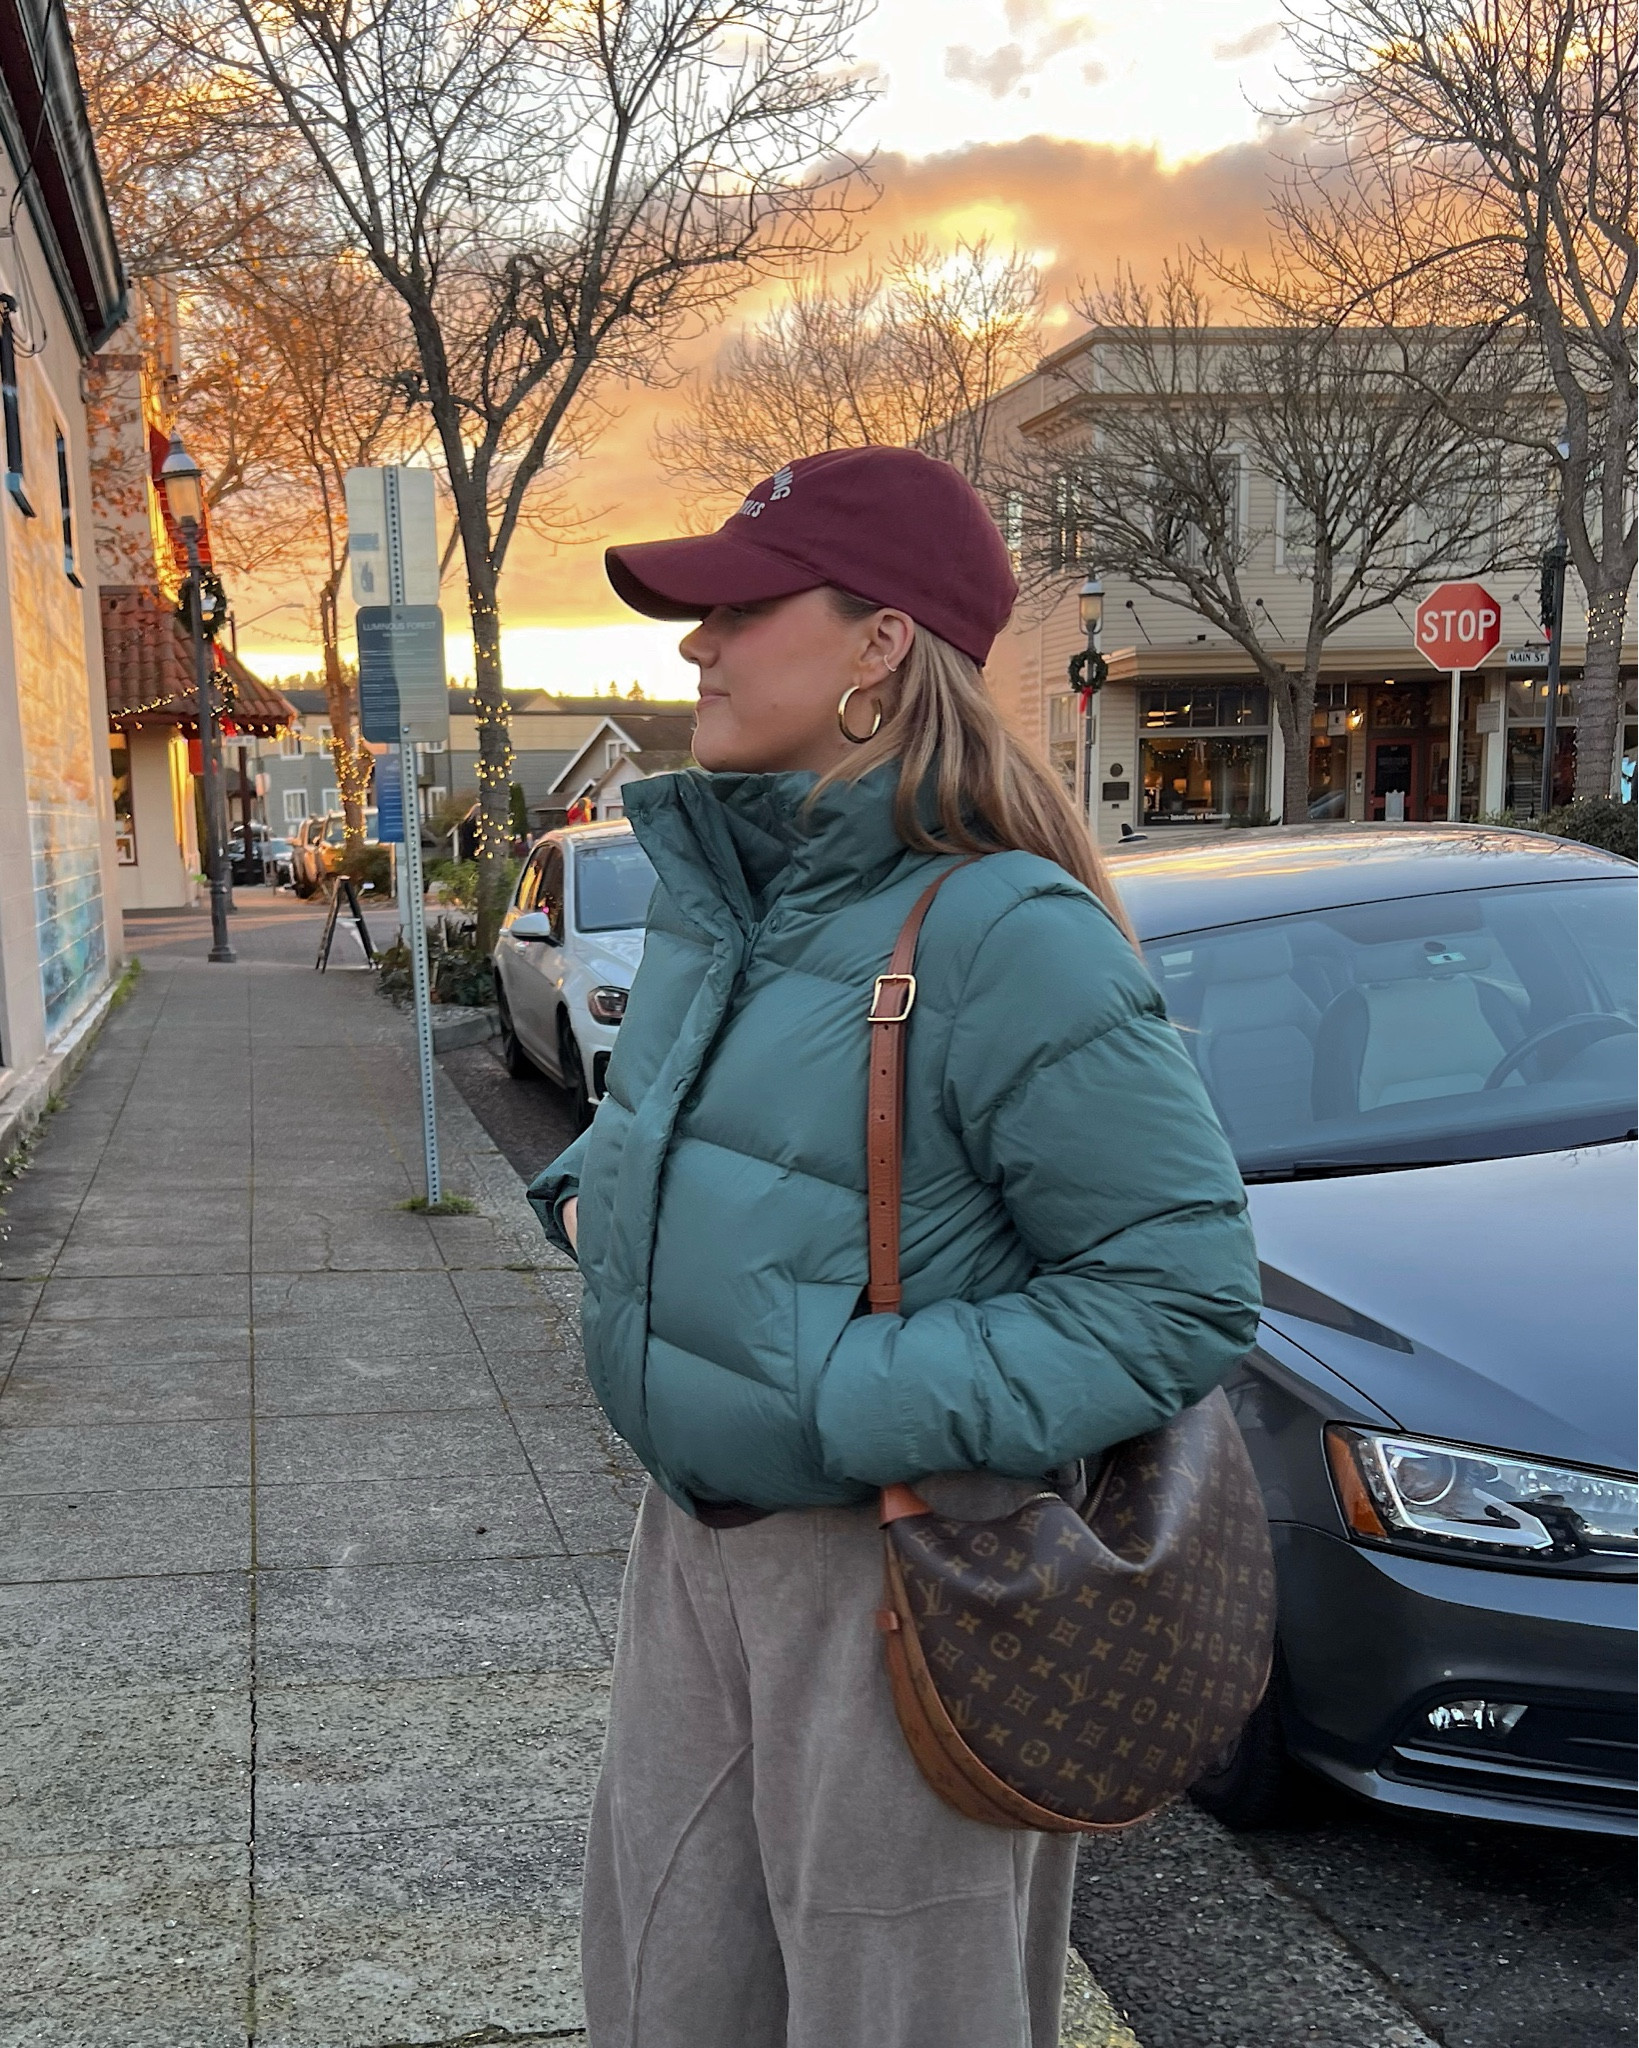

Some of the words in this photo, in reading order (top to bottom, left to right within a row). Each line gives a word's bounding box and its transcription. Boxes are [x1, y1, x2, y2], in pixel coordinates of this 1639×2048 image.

[362, 622, 405, 631] LUMINOUS
[406, 621, 436, 630] FOREST
[1421, 608, 1497, 644] STOP
[1509, 653, 1531, 662] MAIN
